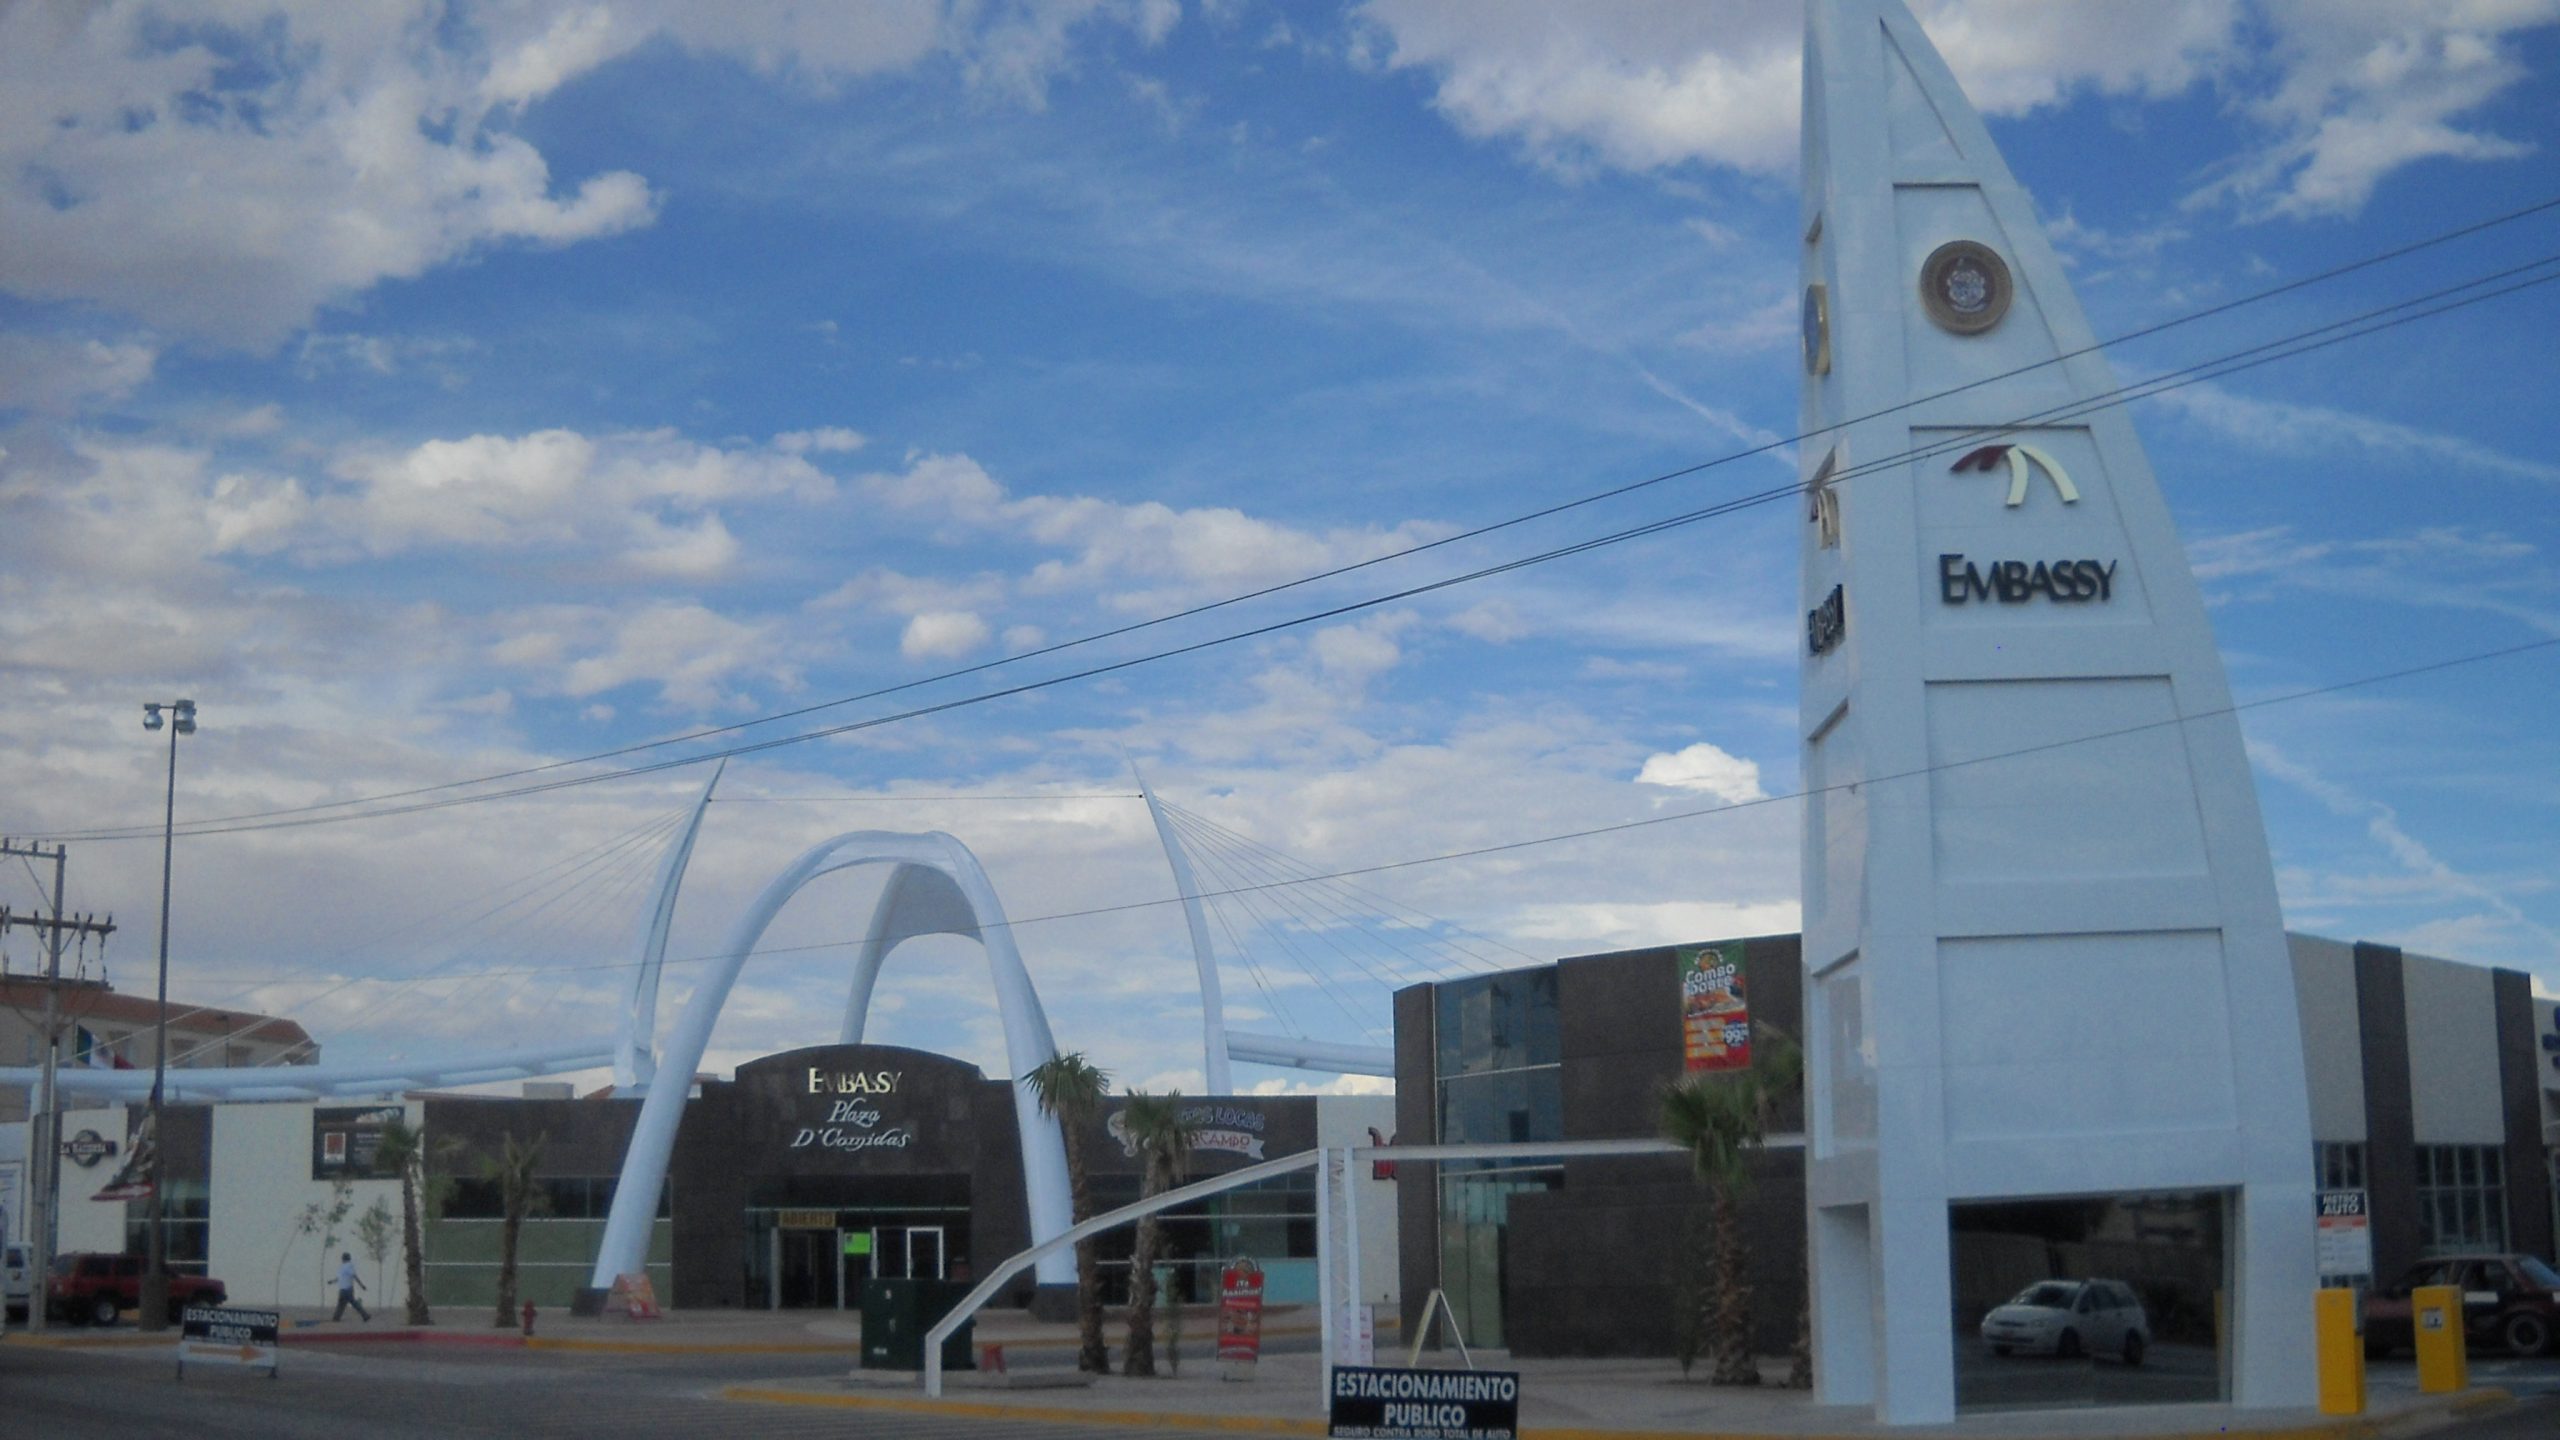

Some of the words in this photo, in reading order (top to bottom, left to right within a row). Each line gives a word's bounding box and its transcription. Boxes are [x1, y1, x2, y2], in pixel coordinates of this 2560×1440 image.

[1939, 554, 2117, 604] EMBASSY
[809, 1067, 902, 1093] EMBASSY
[827, 1097, 880, 1128] Plaza
[1216, 1106, 1265, 1131] LOCAS
[790, 1128, 911, 1151] D'Comidas
[2323, 1203, 2360, 1215] AUTO
[1336, 1372, 1515, 1401] ESTACIONAMIENTO
[1384, 1403, 1466, 1427] PUBLICO
[1334, 1427, 1370, 1438] SEGURO
[1373, 1427, 1411, 1438] CONTRA
[1414, 1428, 1440, 1439] ROBO
[1443, 1428, 1469, 1439] TOTAL
[1472, 1429, 1483, 1439] DE
[1486, 1429, 1511, 1439] AUTO
